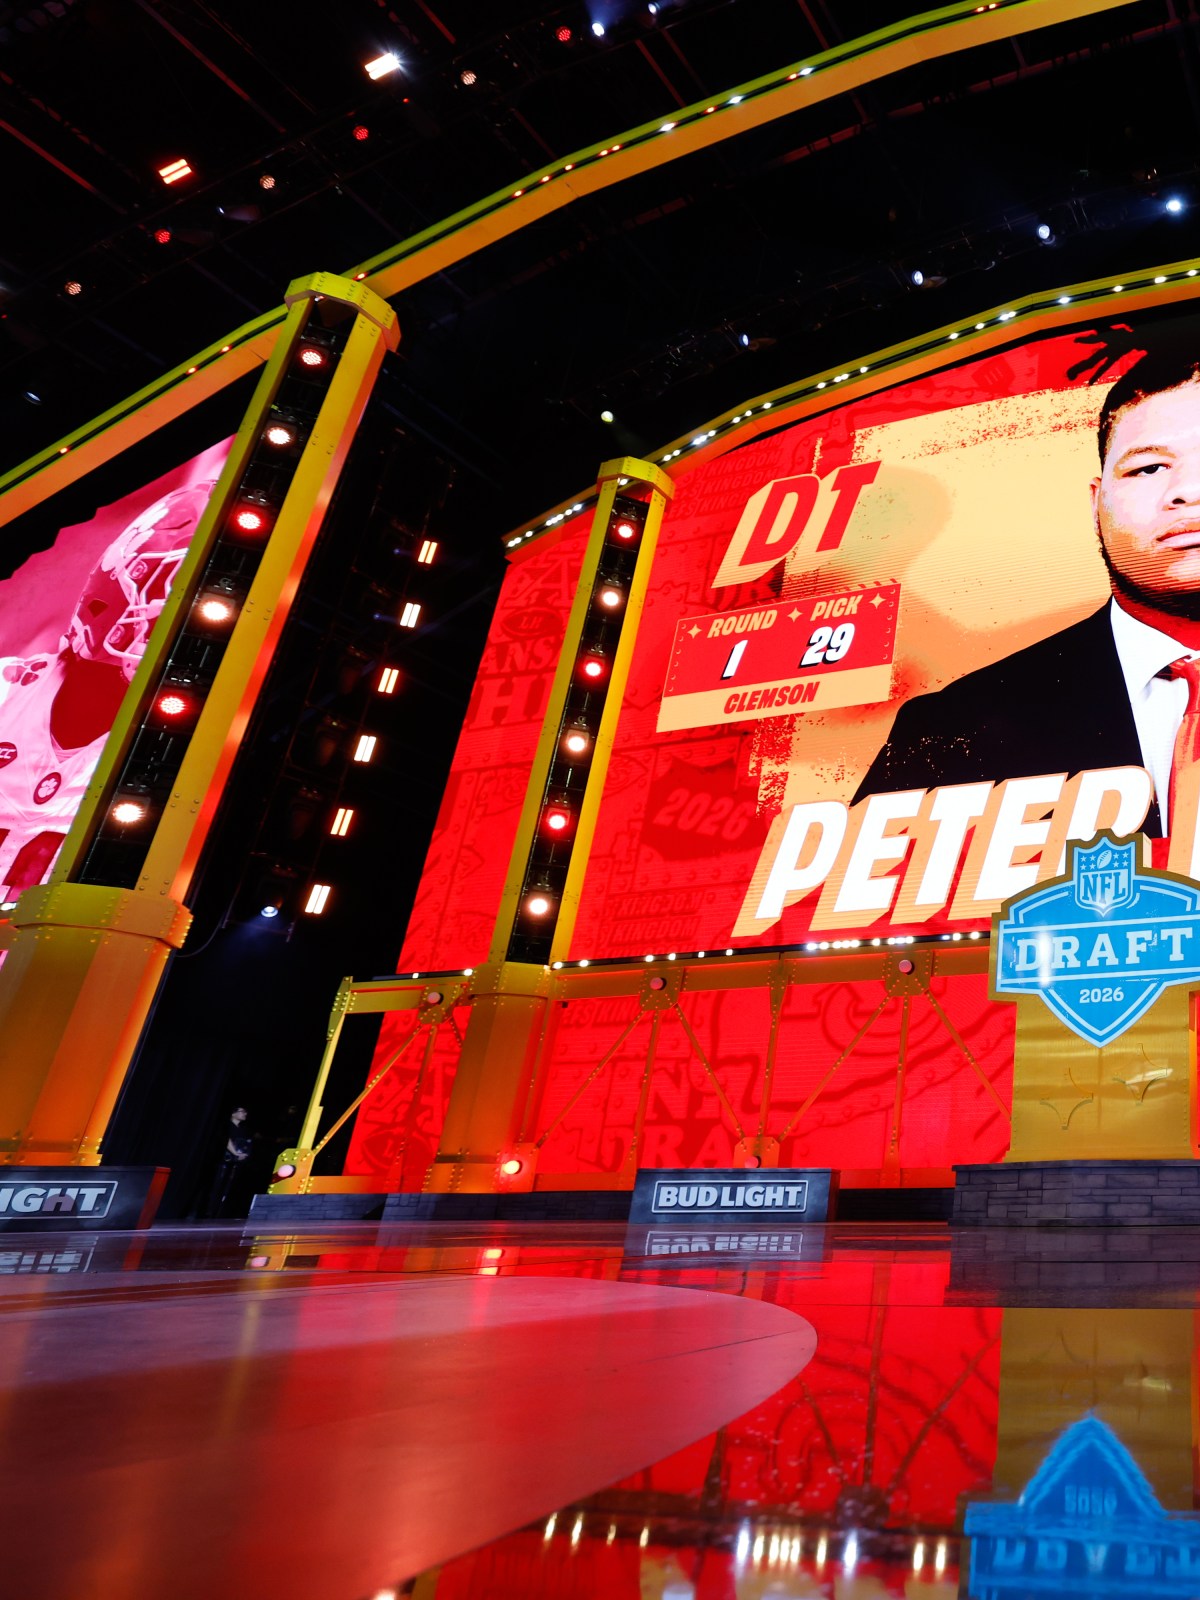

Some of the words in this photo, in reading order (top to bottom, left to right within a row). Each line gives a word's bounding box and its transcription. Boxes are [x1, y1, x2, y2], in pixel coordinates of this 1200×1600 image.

[738, 460, 882, 567] DT
[707, 610, 777, 638] ROUND
[810, 595, 861, 622] PICK
[721, 639, 748, 679] 1
[799, 622, 856, 668] 29
[723, 682, 820, 714] CLEMSON
[652, 787, 757, 841] 2026
[754, 767, 1152, 920] PETER
[1081, 871, 1127, 905] NFL
[1014, 926, 1194, 972] DRAFT
[1079, 987, 1125, 1004] 2026
[658, 1186, 718, 1207] BUD
[720, 1186, 802, 1207] LIGHT
